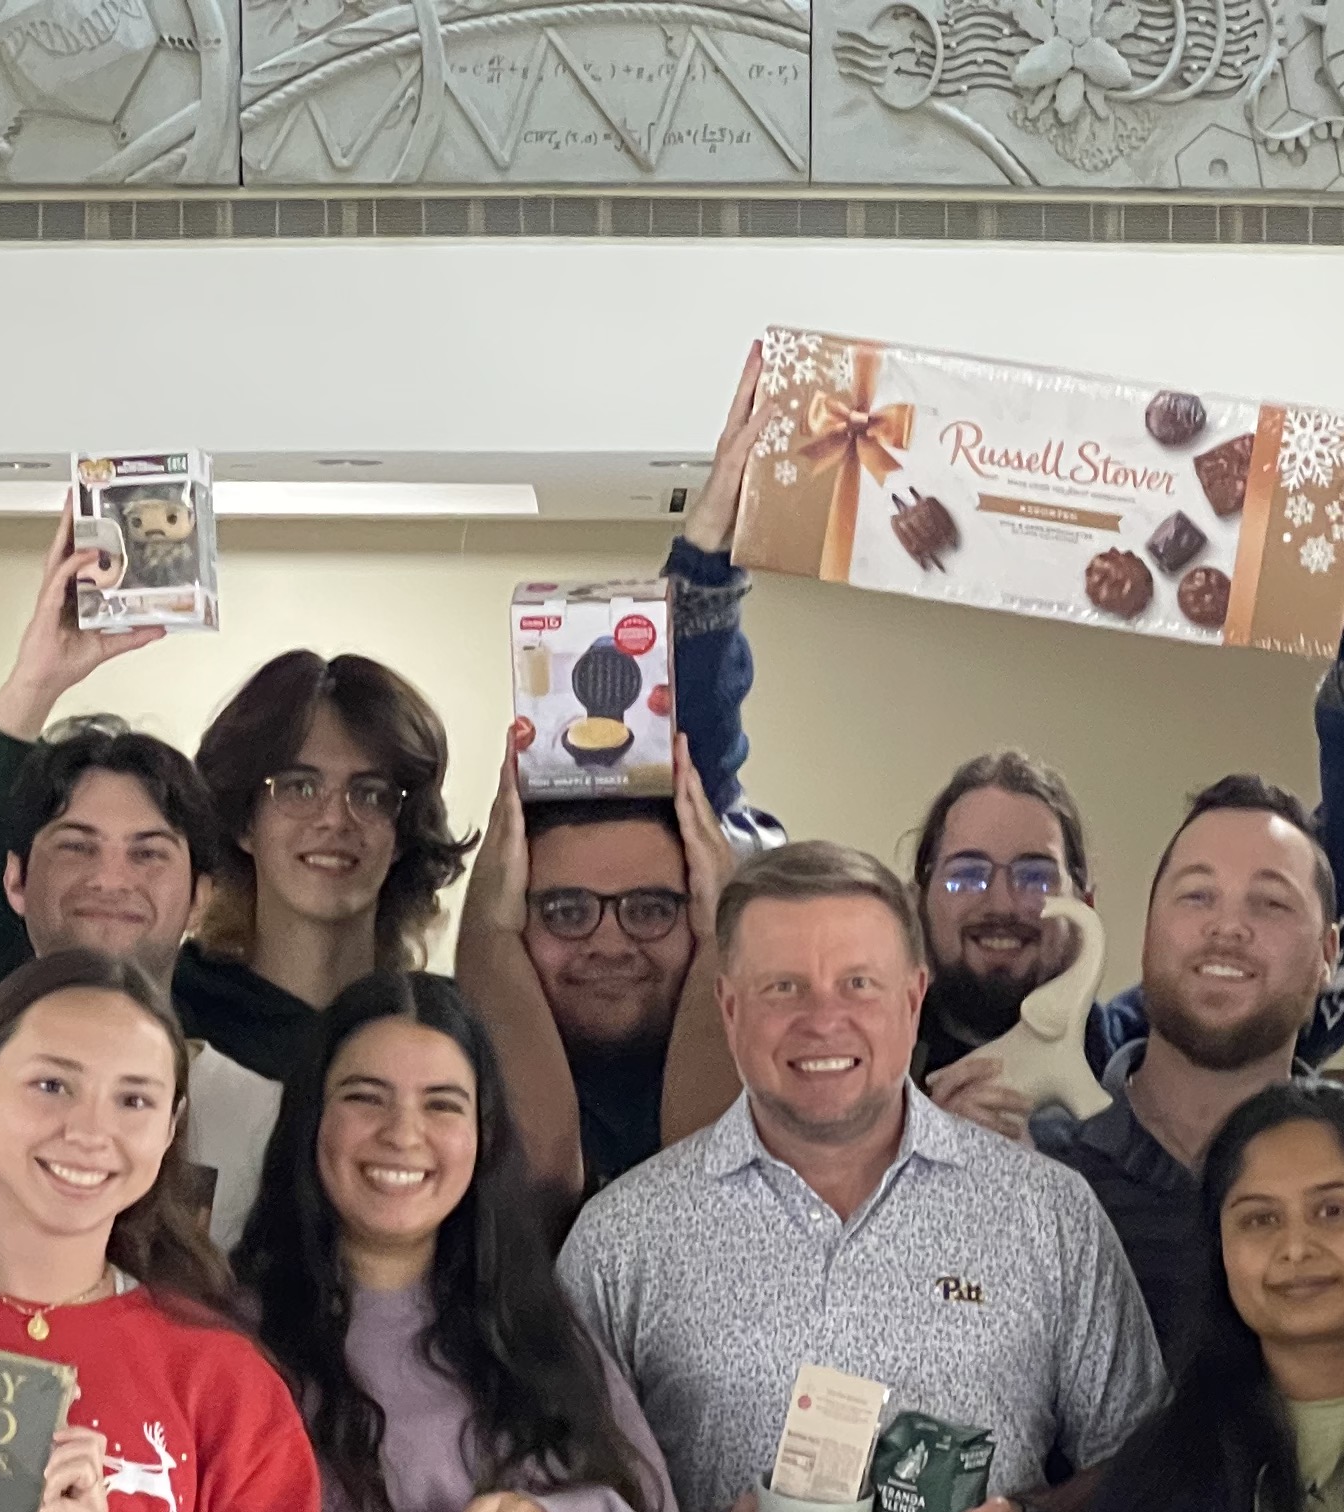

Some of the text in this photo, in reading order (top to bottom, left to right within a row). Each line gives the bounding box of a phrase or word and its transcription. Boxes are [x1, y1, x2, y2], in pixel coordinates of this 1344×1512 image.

[938, 419, 1070, 481] Russell
[1069, 440, 1176, 497] Stover
[876, 1483, 926, 1508] VERANDA
